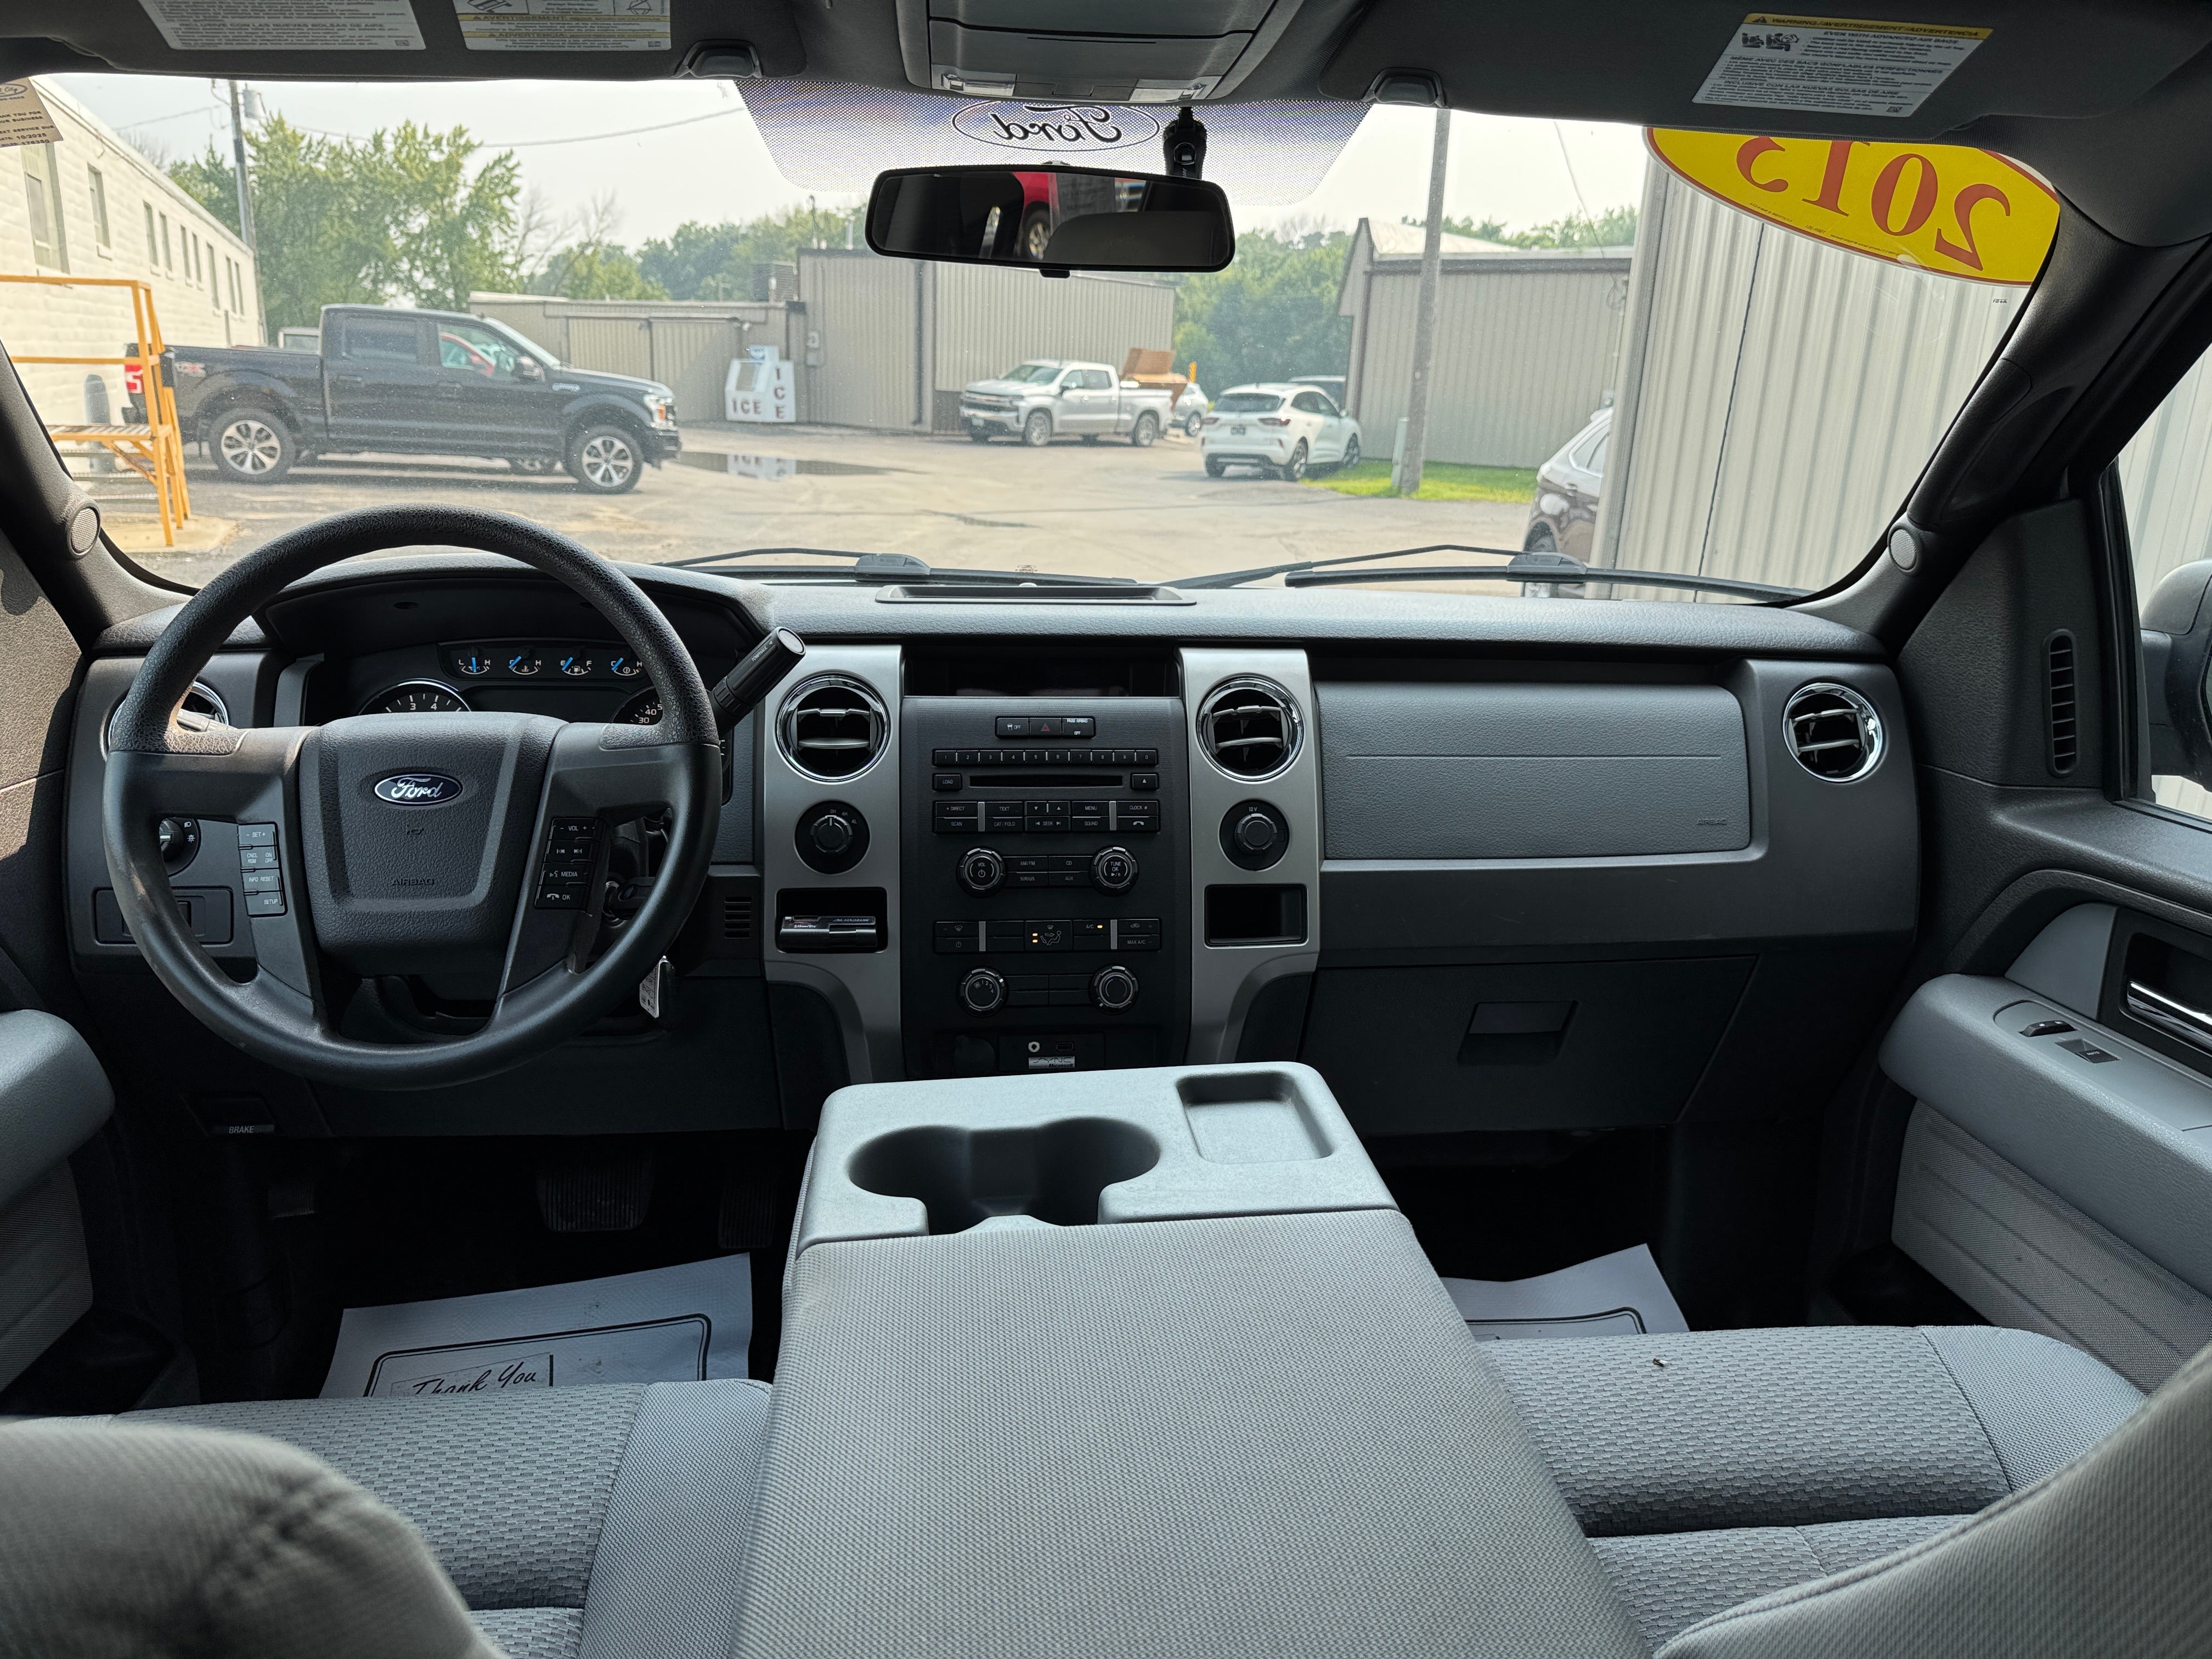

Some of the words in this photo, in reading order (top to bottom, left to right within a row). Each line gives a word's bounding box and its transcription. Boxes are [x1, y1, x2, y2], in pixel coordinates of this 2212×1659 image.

[732, 399, 761, 415] ICE
[410, 703, 416, 711] 3
[431, 703, 437, 711] 4
[391, 777, 444, 800] Ford
[392, 878, 435, 886] AIRBAG
[229, 1126, 255, 1134] BRAKE
[415, 1369, 488, 1396] Thank
[497, 1361, 537, 1389] You
